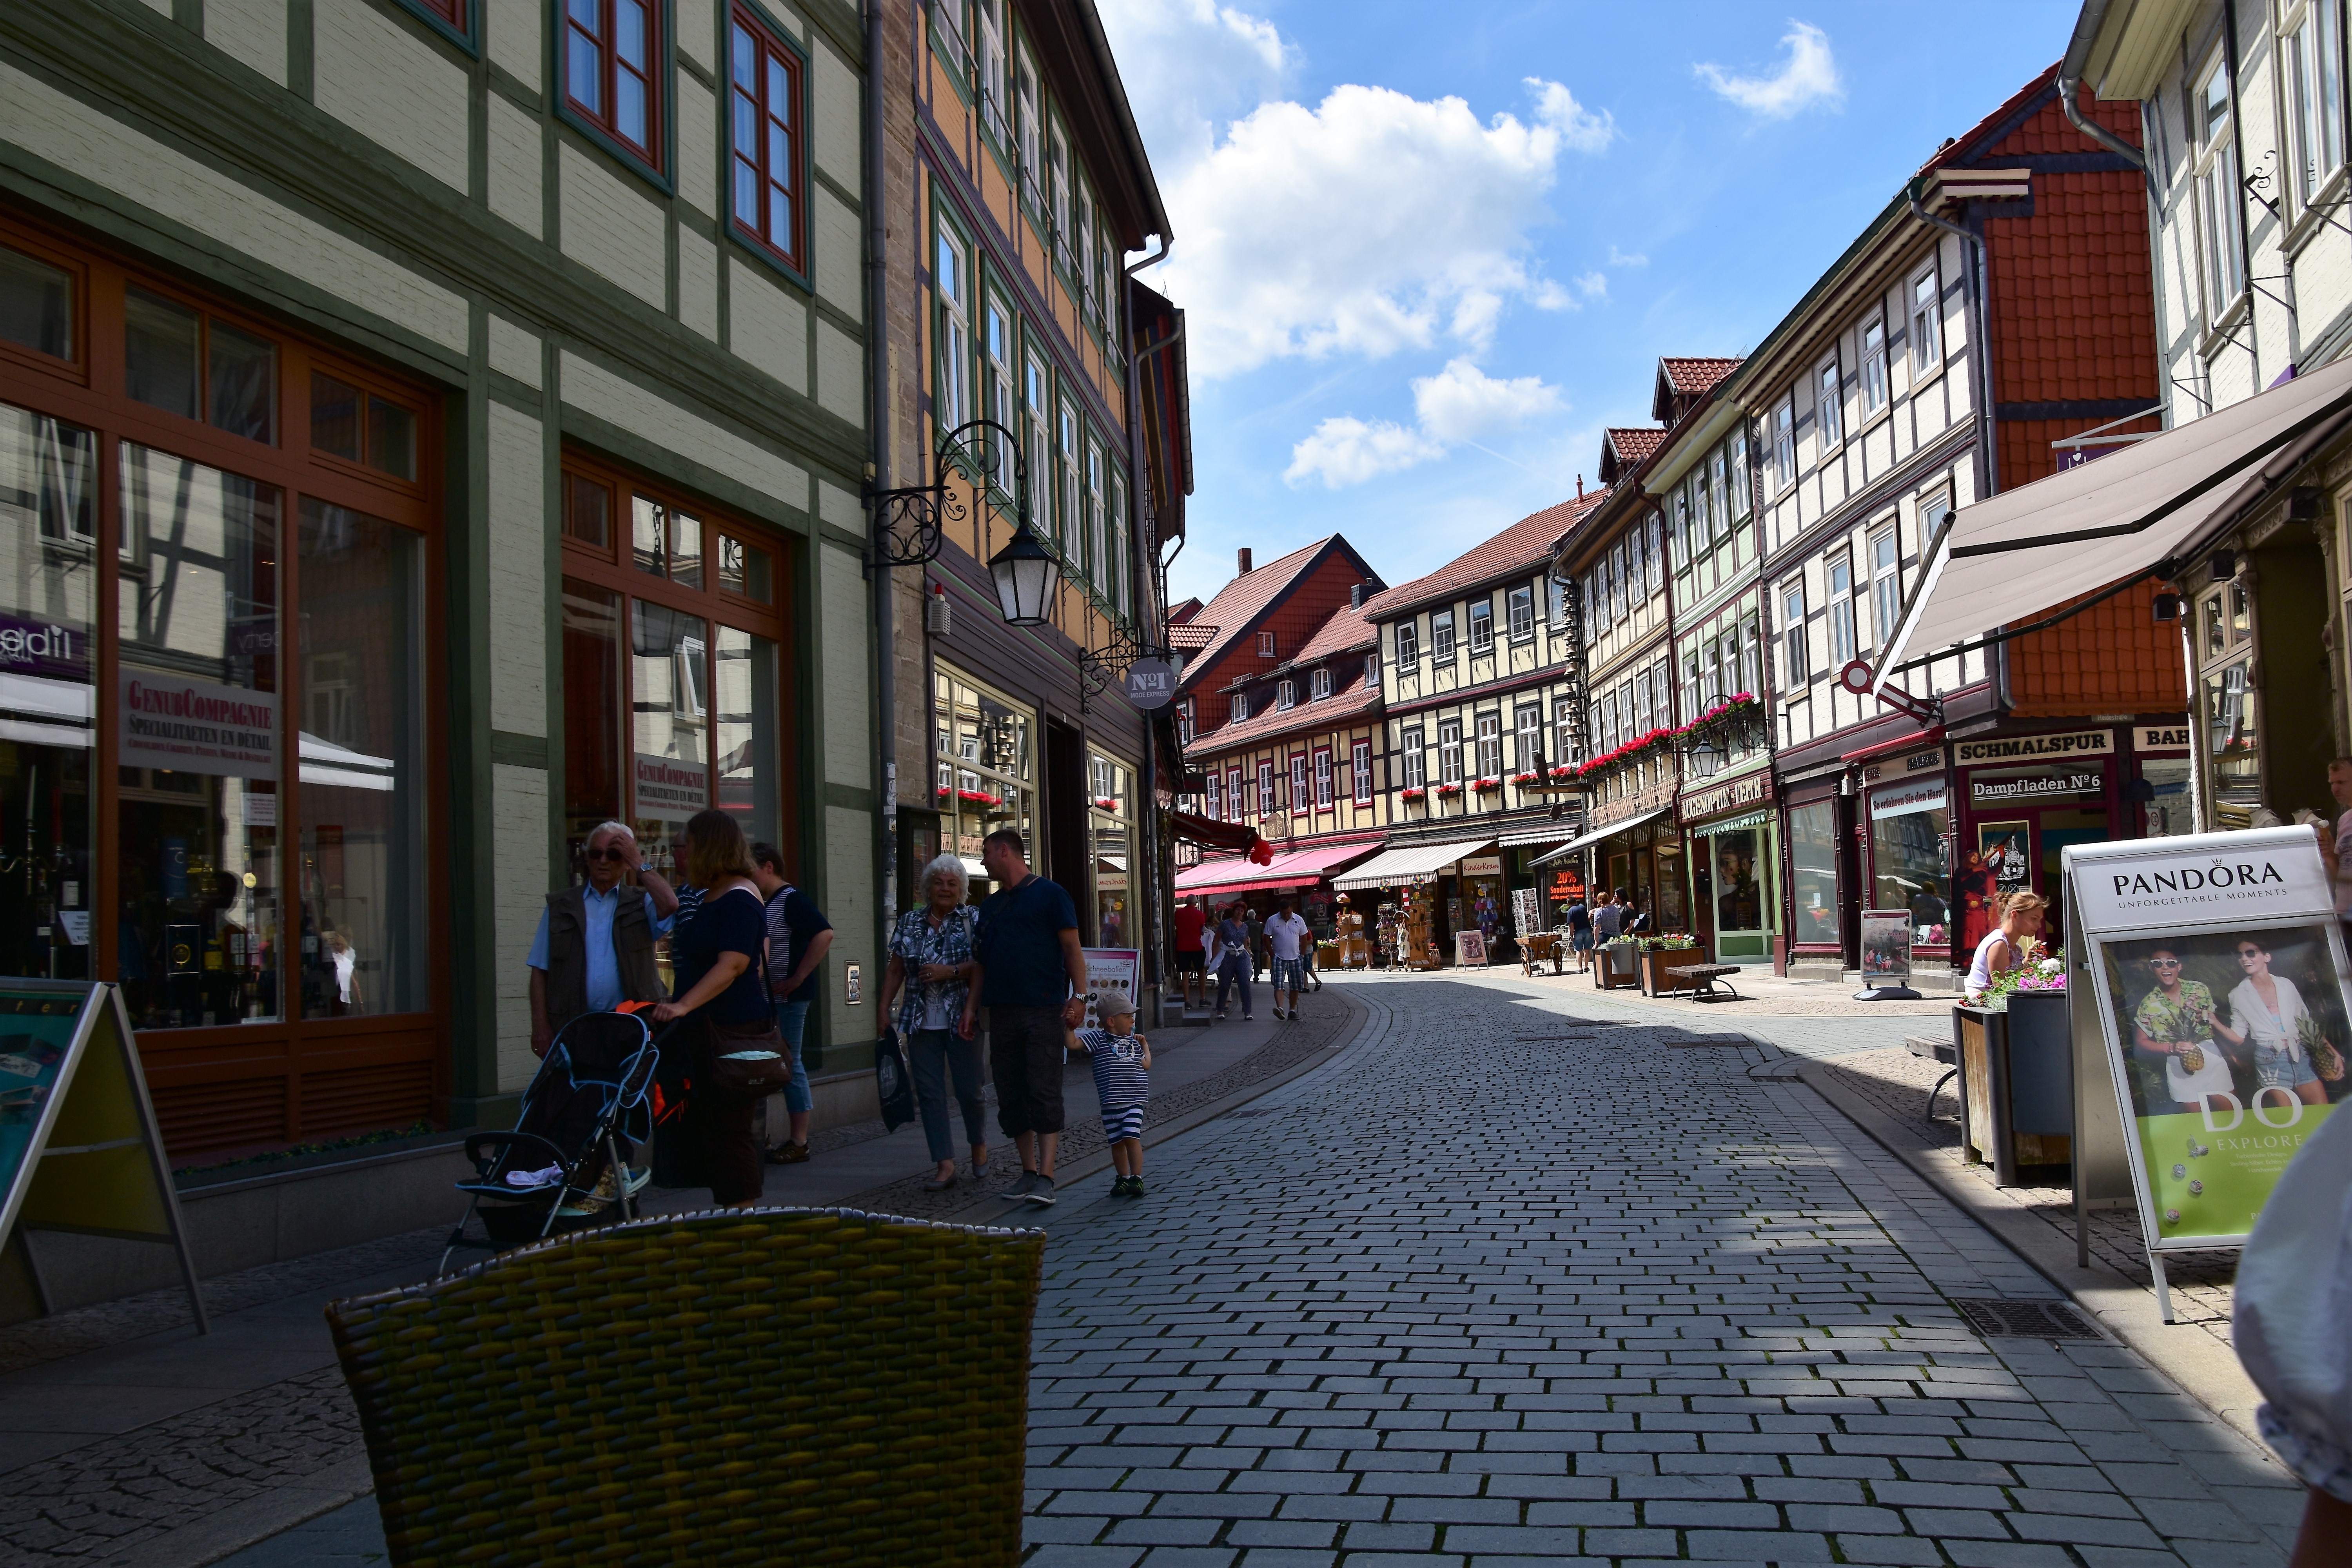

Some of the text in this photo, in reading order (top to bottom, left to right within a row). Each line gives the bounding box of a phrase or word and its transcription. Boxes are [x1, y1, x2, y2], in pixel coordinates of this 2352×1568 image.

[222, 730, 234, 745] EN
[1960, 733, 2106, 760] SCHMALSPUR
[1974, 779, 2067, 796] Dampfladen
[1682, 787, 1730, 819] AUGENOPTIK
[1735, 777, 1762, 804] VEITH
[1873, 787, 1944, 811] So erfahren Sie den Harz!
[1463, 862, 1499, 871] KinderKram
[1557, 871, 1576, 884] 20%
[2113, 862, 2283, 896] PANDORA
[1550, 884, 1584, 894] Sonderrabatt
[2119, 888, 2288, 909] UNFORGETTABLE MOMENTS
[2198, 1085, 2303, 1132] DO
[2218, 1134, 2302, 1150] EXPLORE
